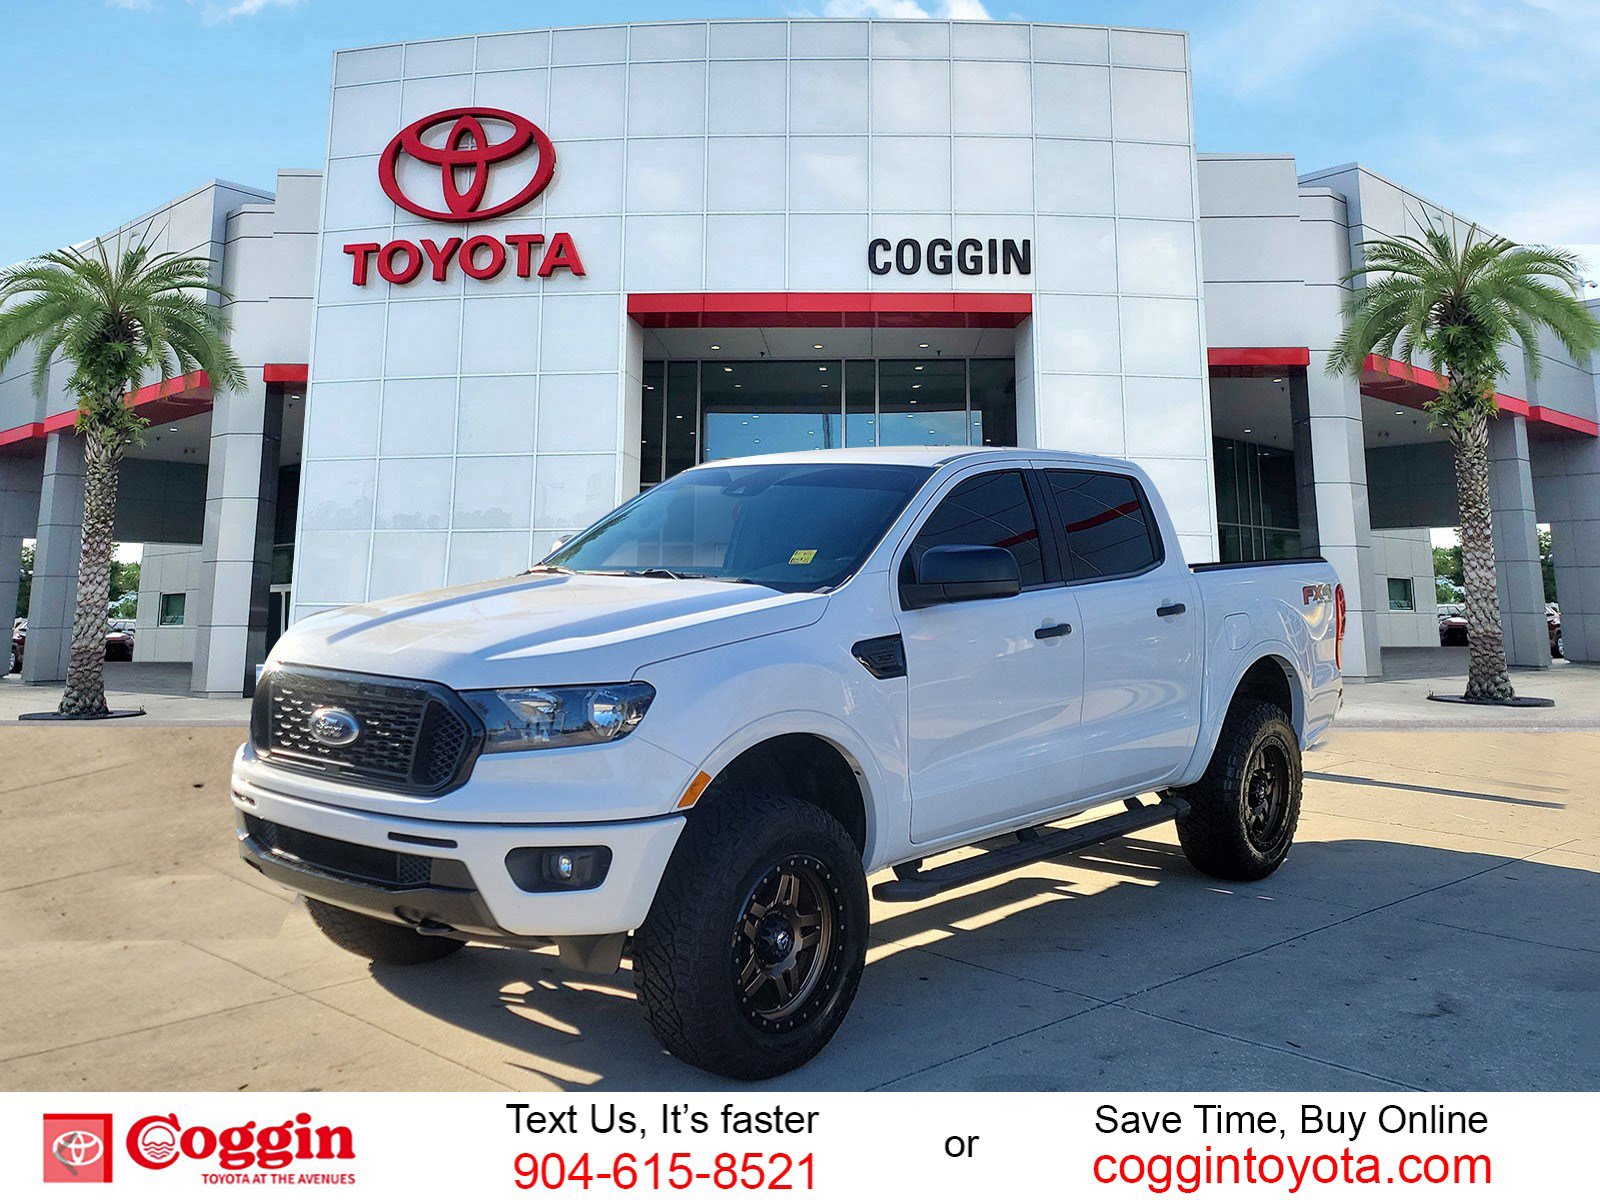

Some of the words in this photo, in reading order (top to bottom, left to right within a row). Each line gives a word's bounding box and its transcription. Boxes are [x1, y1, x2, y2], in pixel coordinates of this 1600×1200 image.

[343, 232, 586, 286] TOYOTA
[867, 238, 1033, 276] COGGIN
[1302, 583, 1333, 606] FX4
